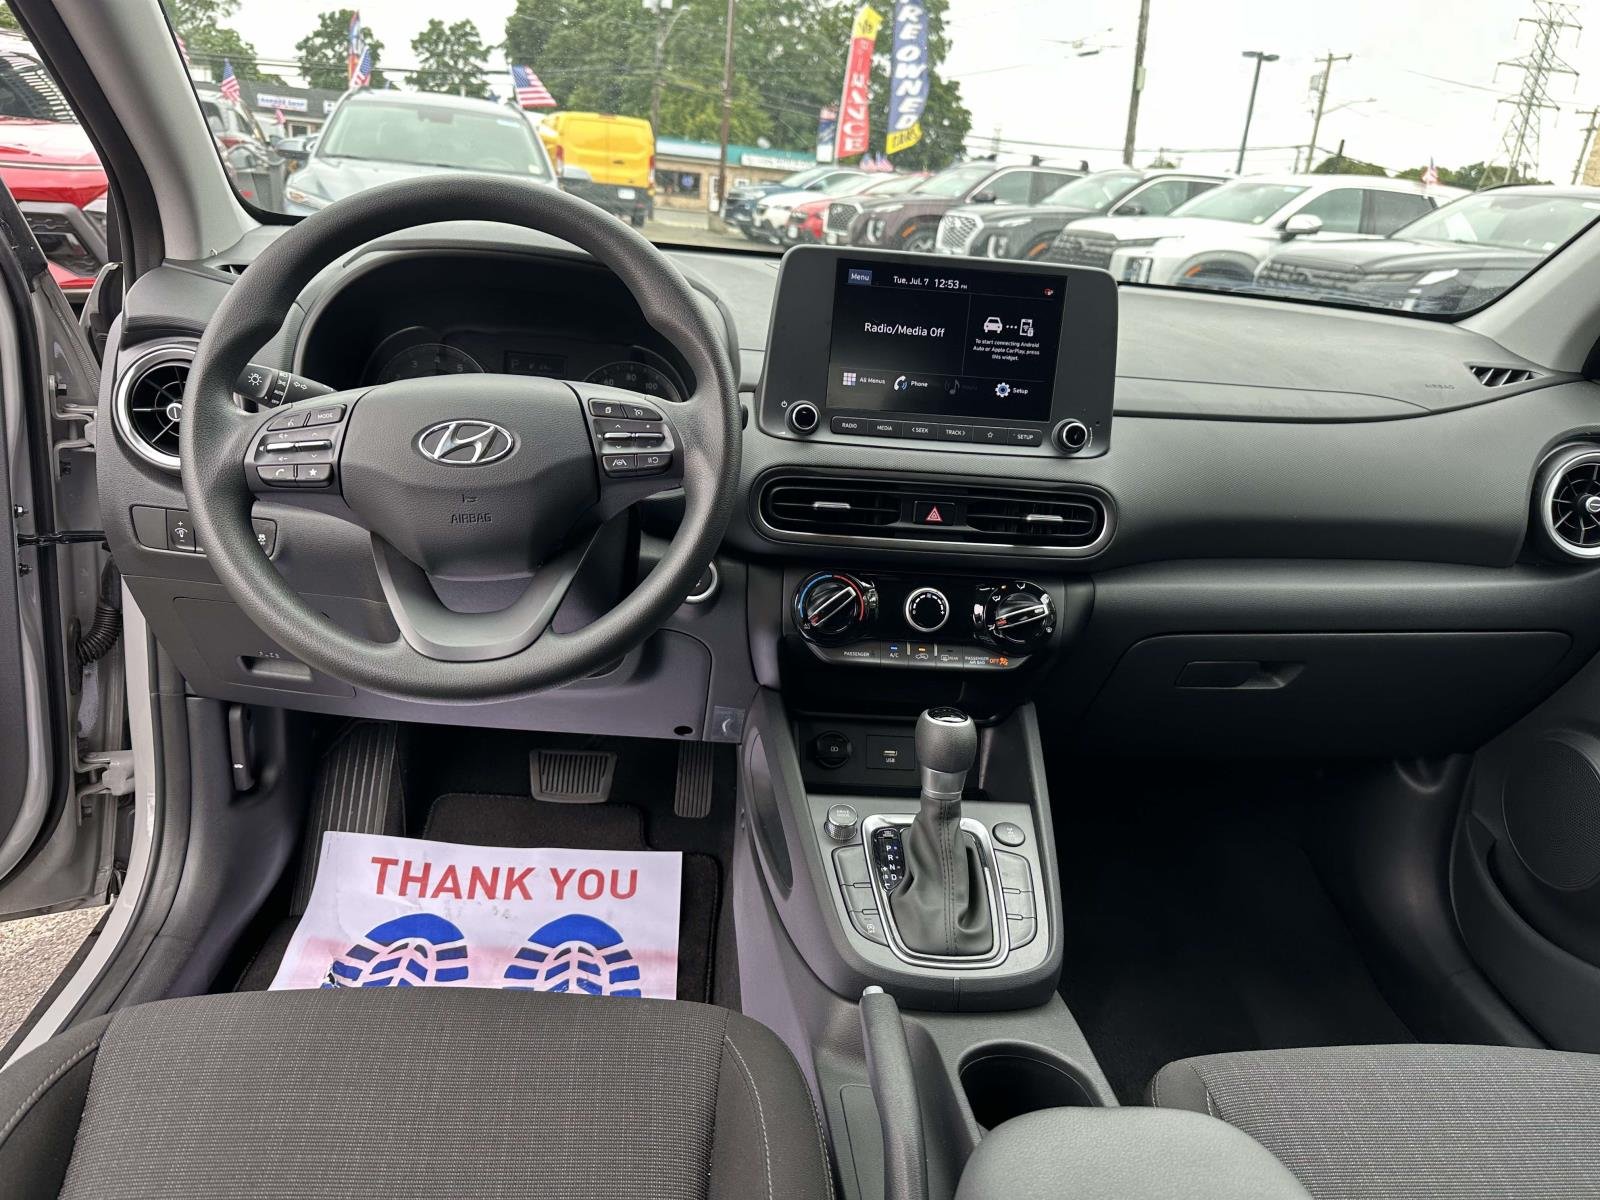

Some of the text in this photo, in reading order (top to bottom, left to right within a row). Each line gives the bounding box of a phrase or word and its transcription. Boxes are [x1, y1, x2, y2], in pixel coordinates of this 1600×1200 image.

[895, 0, 926, 130] RE OWNED
[850, 272, 870, 281] Menu
[924, 278, 929, 286] 7
[934, 278, 959, 289] 12:53
[864, 322, 945, 338] Radio/Media Off
[994, 340, 1020, 348] connecting
[626, 373, 637, 381] 80
[868, 377, 886, 385] Menus
[645, 382, 658, 390] 100
[1012, 387, 1028, 395] Setup
[317, 412, 334, 420] MODE
[841, 422, 858, 430] RADIO
[451, 513, 492, 524] AIRBAG
[371, 856, 639, 900] THANK YOU
